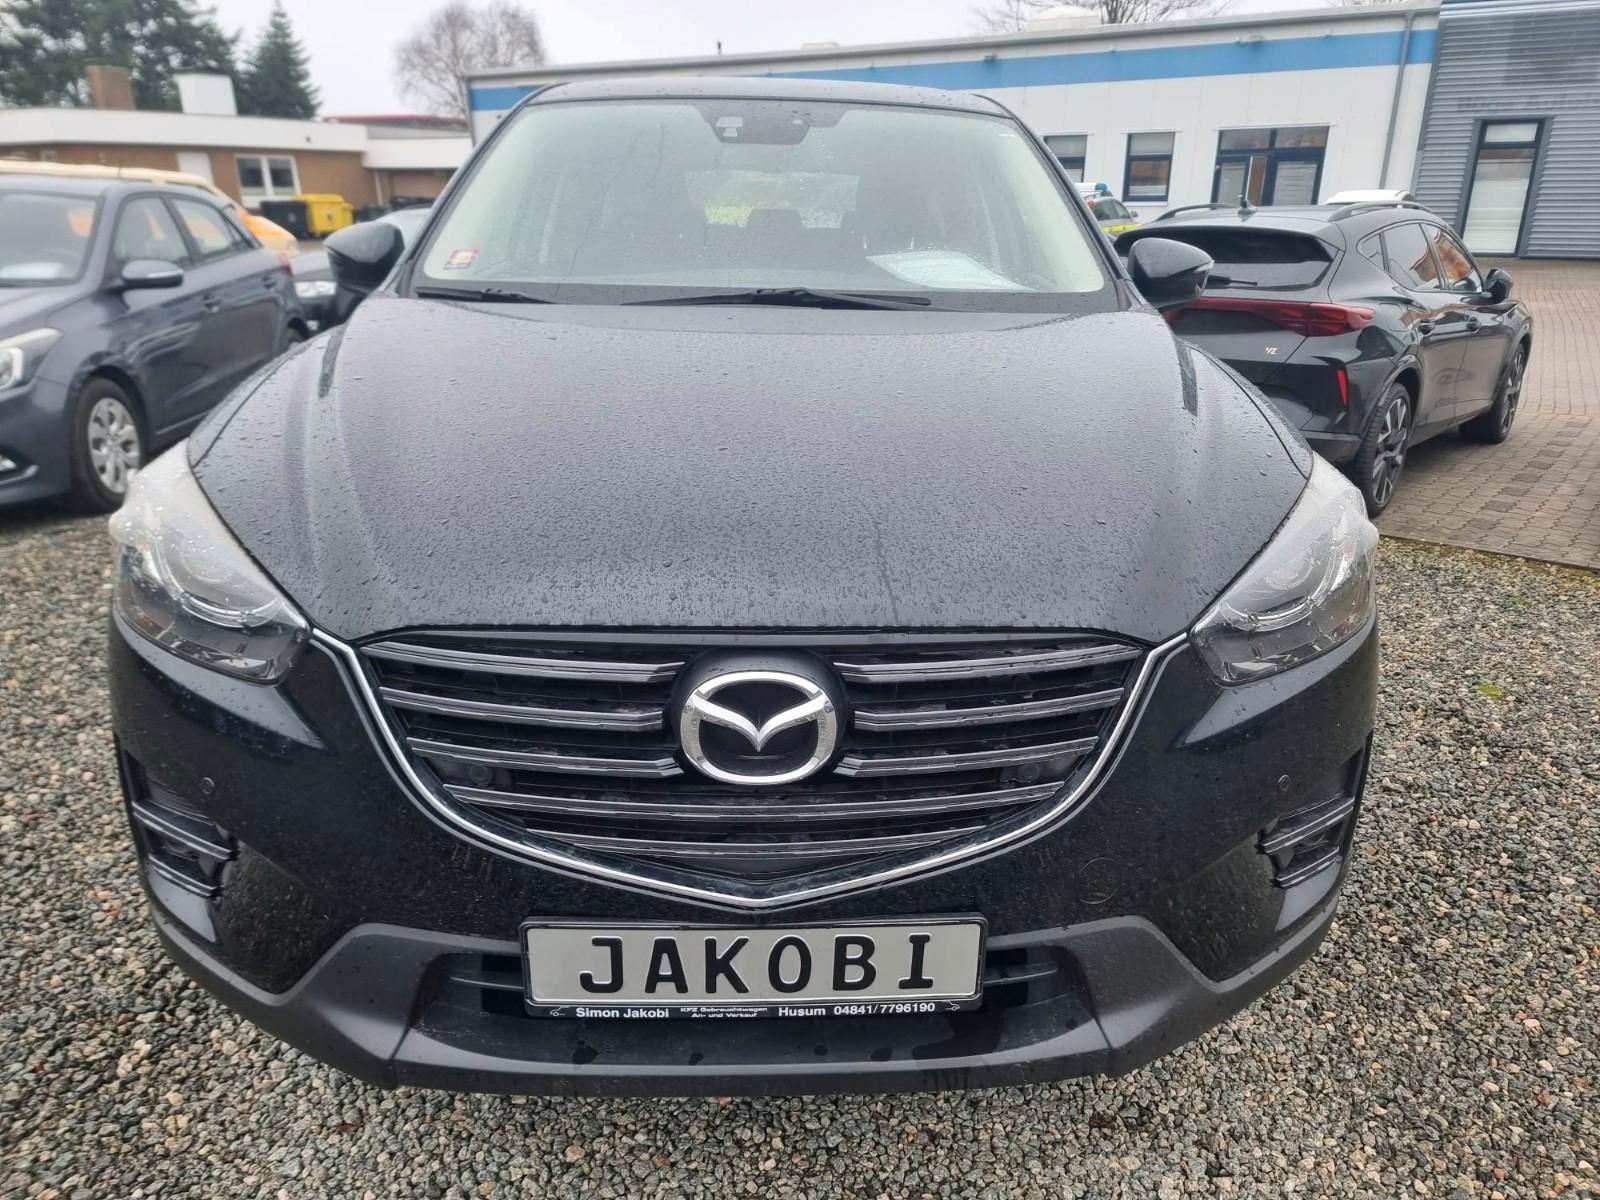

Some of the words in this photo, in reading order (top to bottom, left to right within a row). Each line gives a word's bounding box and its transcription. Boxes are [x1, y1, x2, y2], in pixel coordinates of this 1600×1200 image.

[579, 933, 934, 994] JAKOBI
[575, 1007, 619, 1018] Simon
[623, 1008, 669, 1018] Jakobi
[778, 1007, 826, 1017] Husum
[833, 1003, 936, 1015] 04841/7796190
